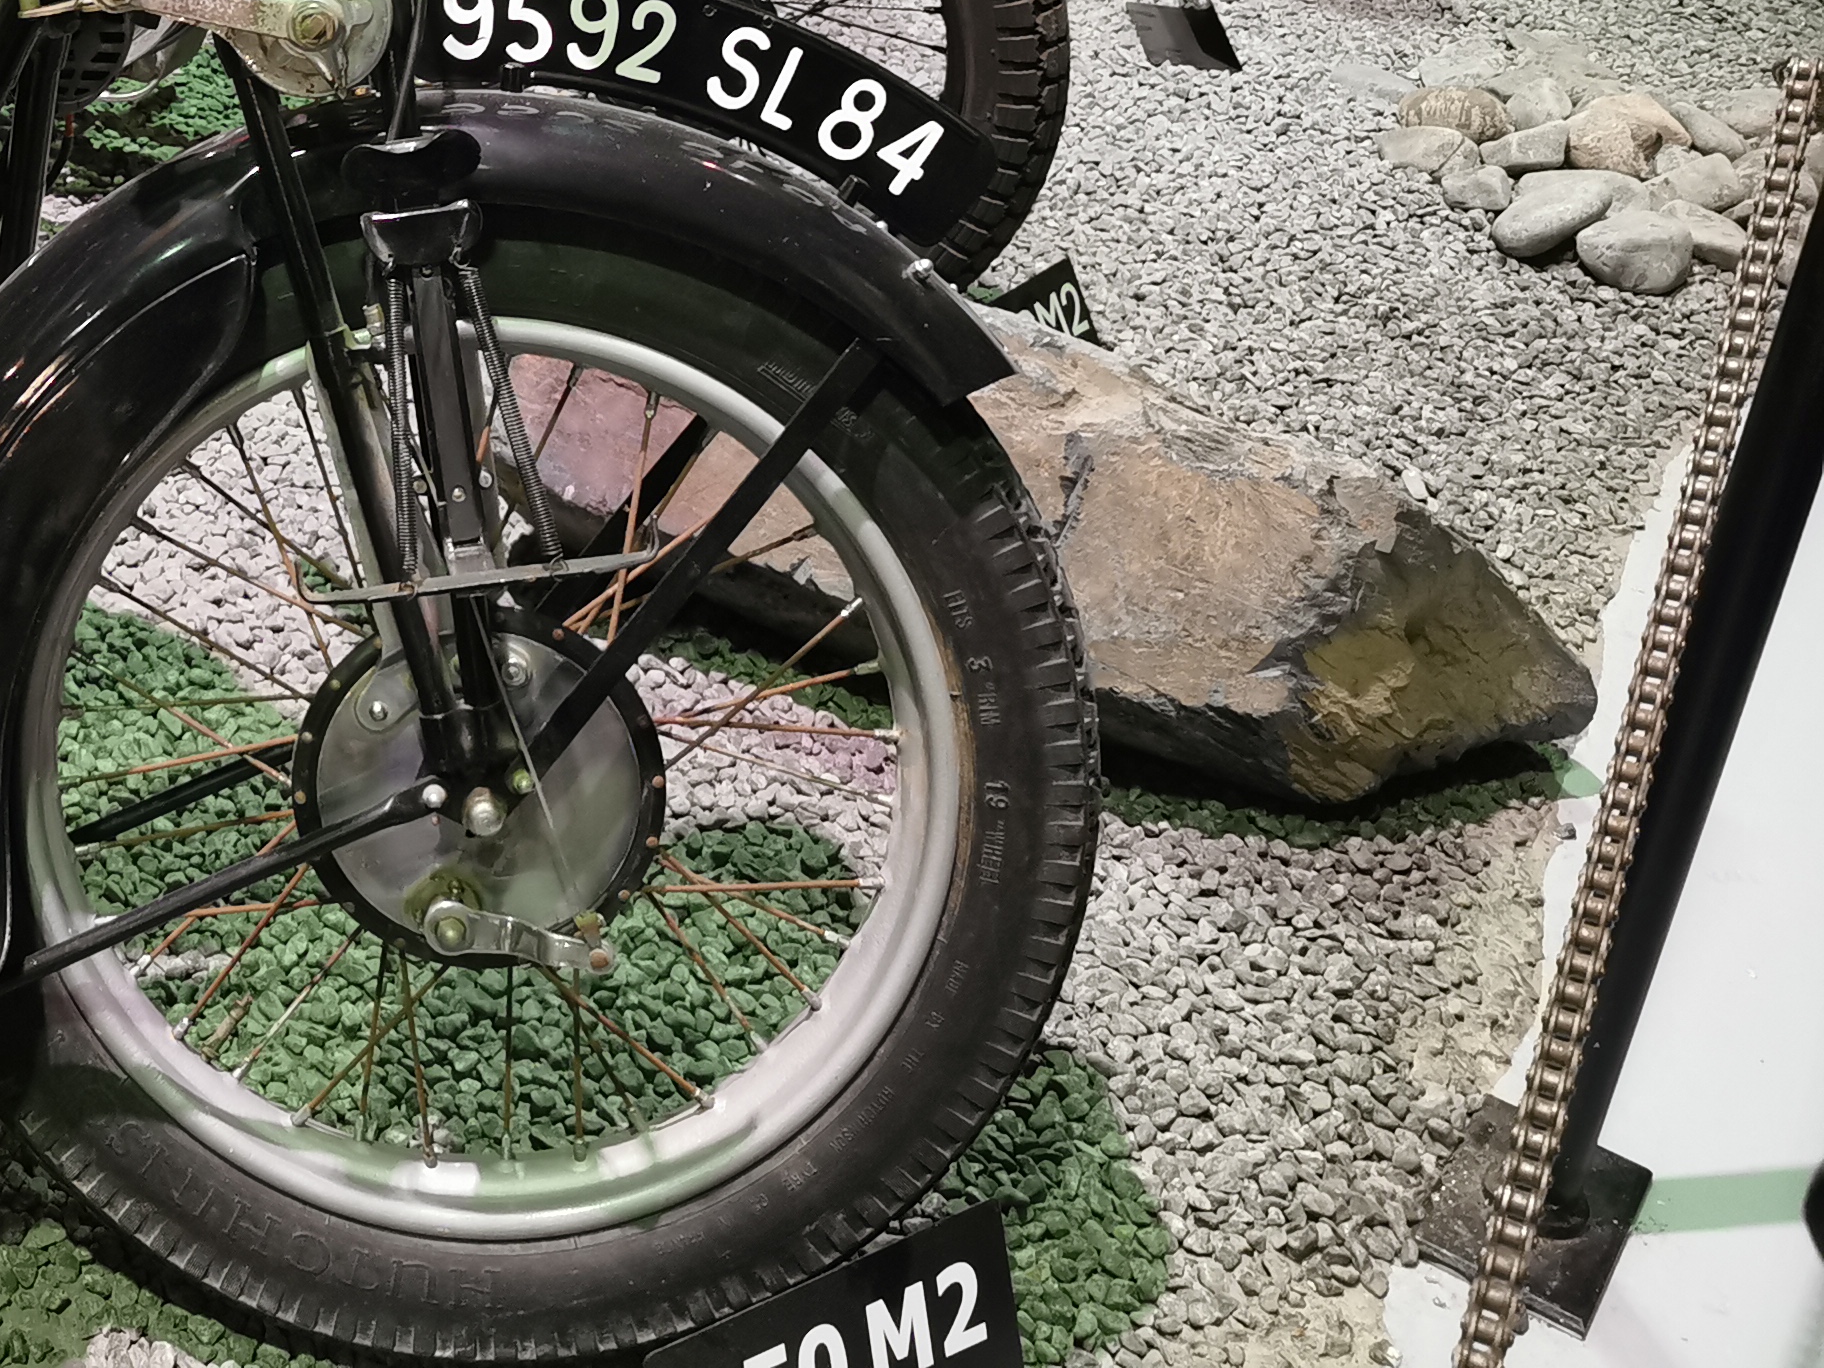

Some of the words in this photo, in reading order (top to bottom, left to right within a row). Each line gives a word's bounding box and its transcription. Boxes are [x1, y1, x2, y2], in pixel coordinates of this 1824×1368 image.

[706, 27, 804, 131] SL
[818, 78, 945, 196] 84
[865, 1261, 988, 1368] M2
